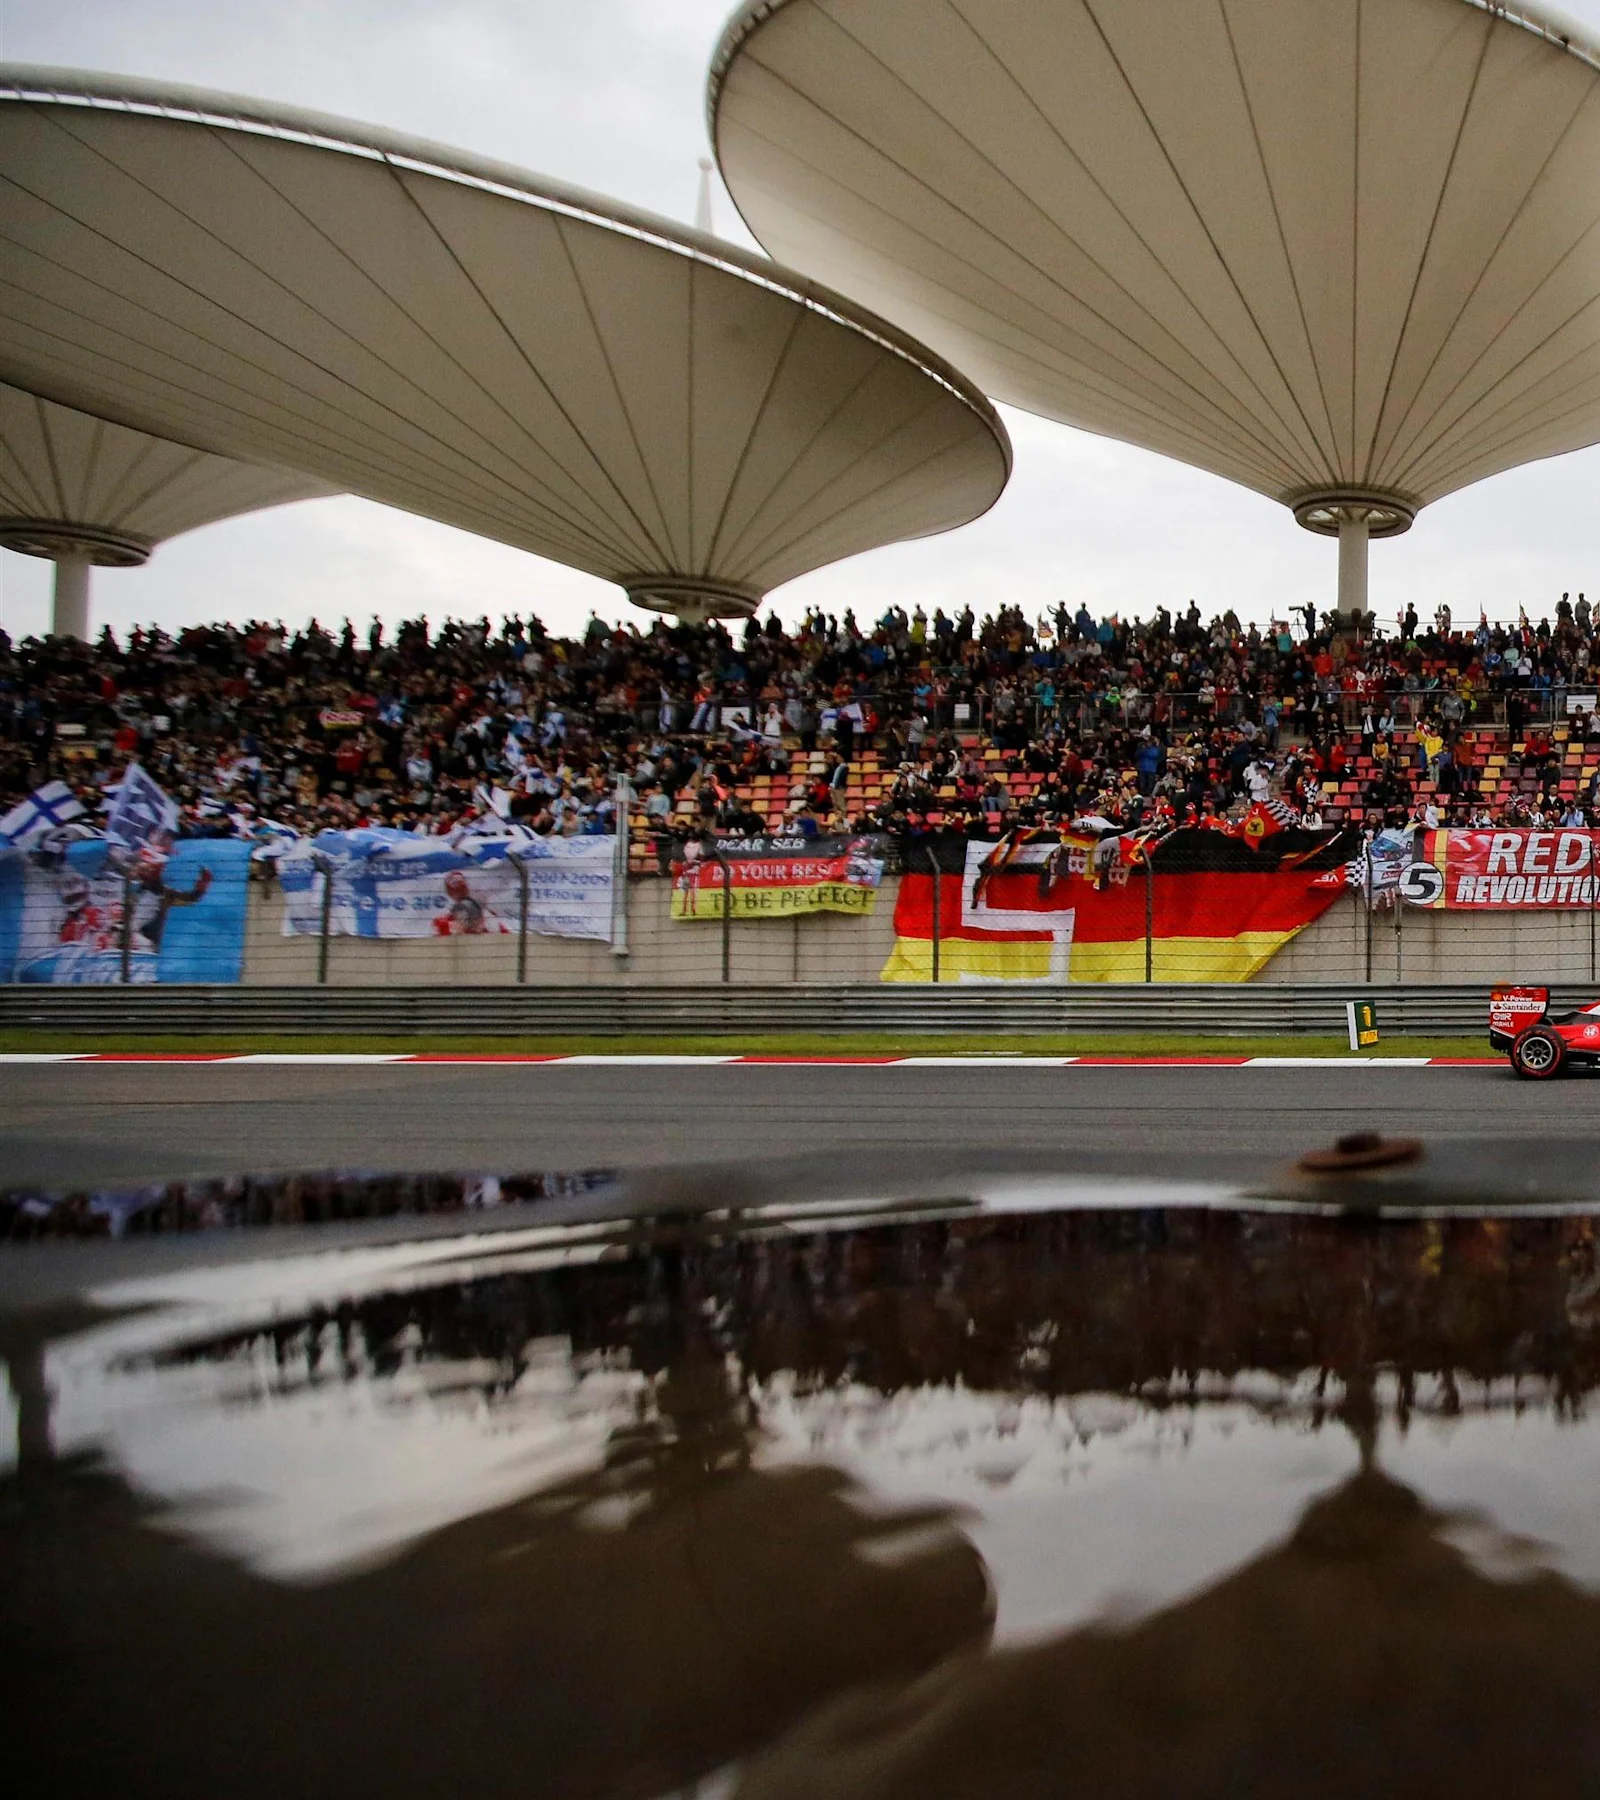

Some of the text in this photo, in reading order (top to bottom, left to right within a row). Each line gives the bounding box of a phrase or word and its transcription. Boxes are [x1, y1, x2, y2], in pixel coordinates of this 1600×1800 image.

[716, 838, 806, 851] DEAR SEB
[1486, 832, 1593, 873] RED
[738, 864, 787, 880] YOUR
[1402, 868, 1439, 899] 5
[710, 892, 738, 911] TO
[744, 891, 772, 909] BE
[1502, 994, 1533, 1002] V-Power
[1502, 1002, 1541, 1011] Santander
